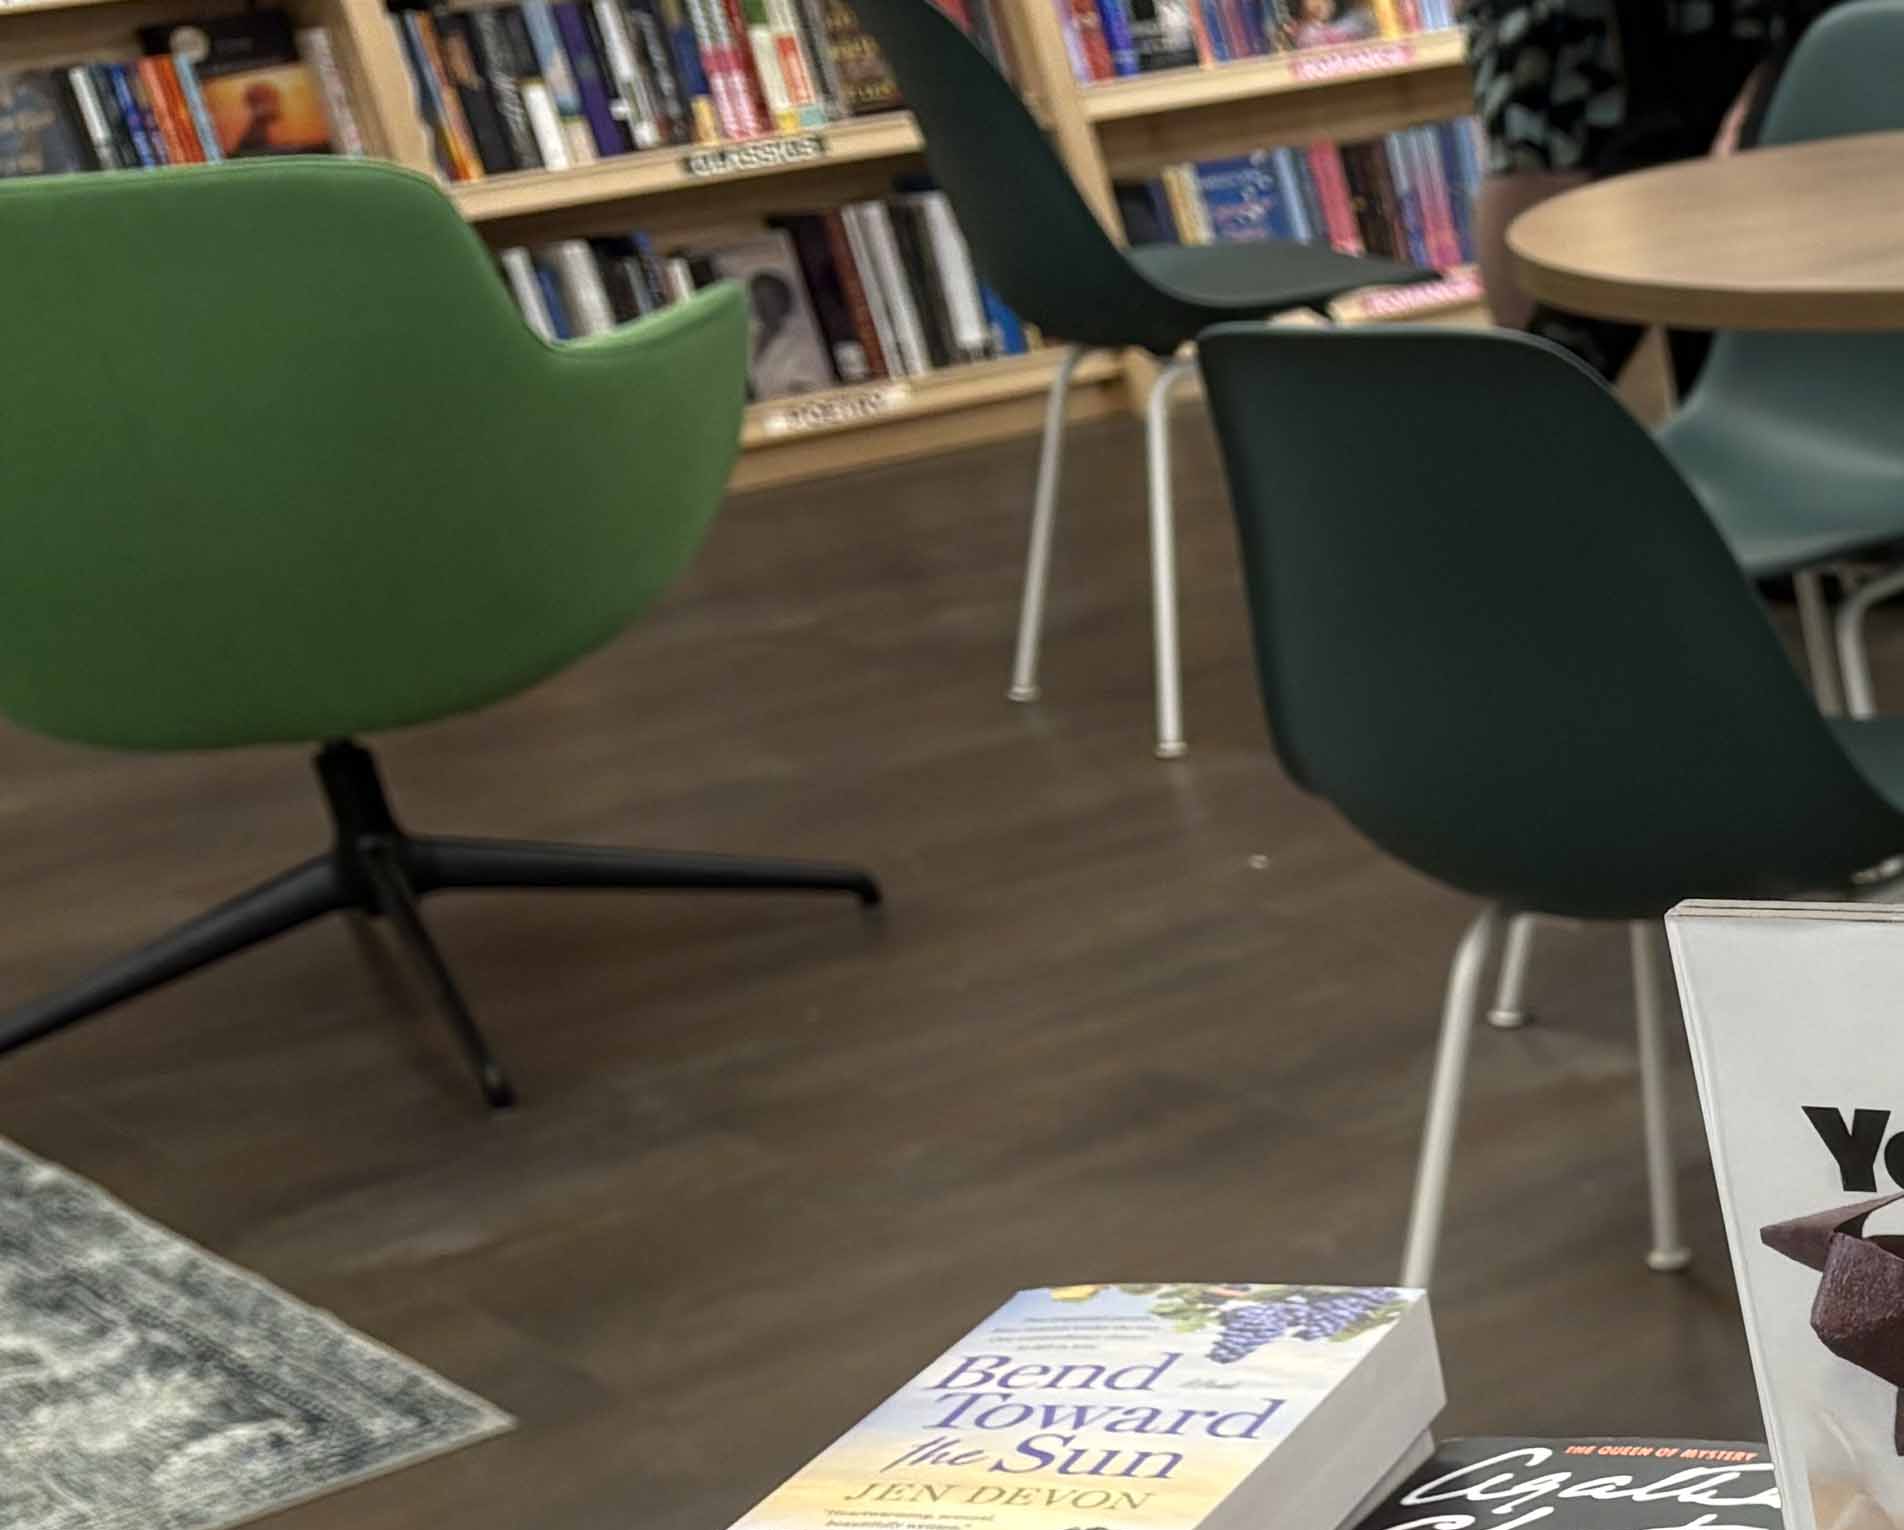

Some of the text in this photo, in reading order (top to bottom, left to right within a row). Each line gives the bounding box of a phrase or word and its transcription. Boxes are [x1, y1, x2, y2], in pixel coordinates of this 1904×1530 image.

[921, 1353, 1184, 1392] Bend
[922, 1392, 1286, 1440] Toward
[879, 1433, 1184, 1479] the Sun
[1598, 1445, 1760, 1461] QUEEN MYSTERY
[844, 1483, 1154, 1510] JEN DEVON
